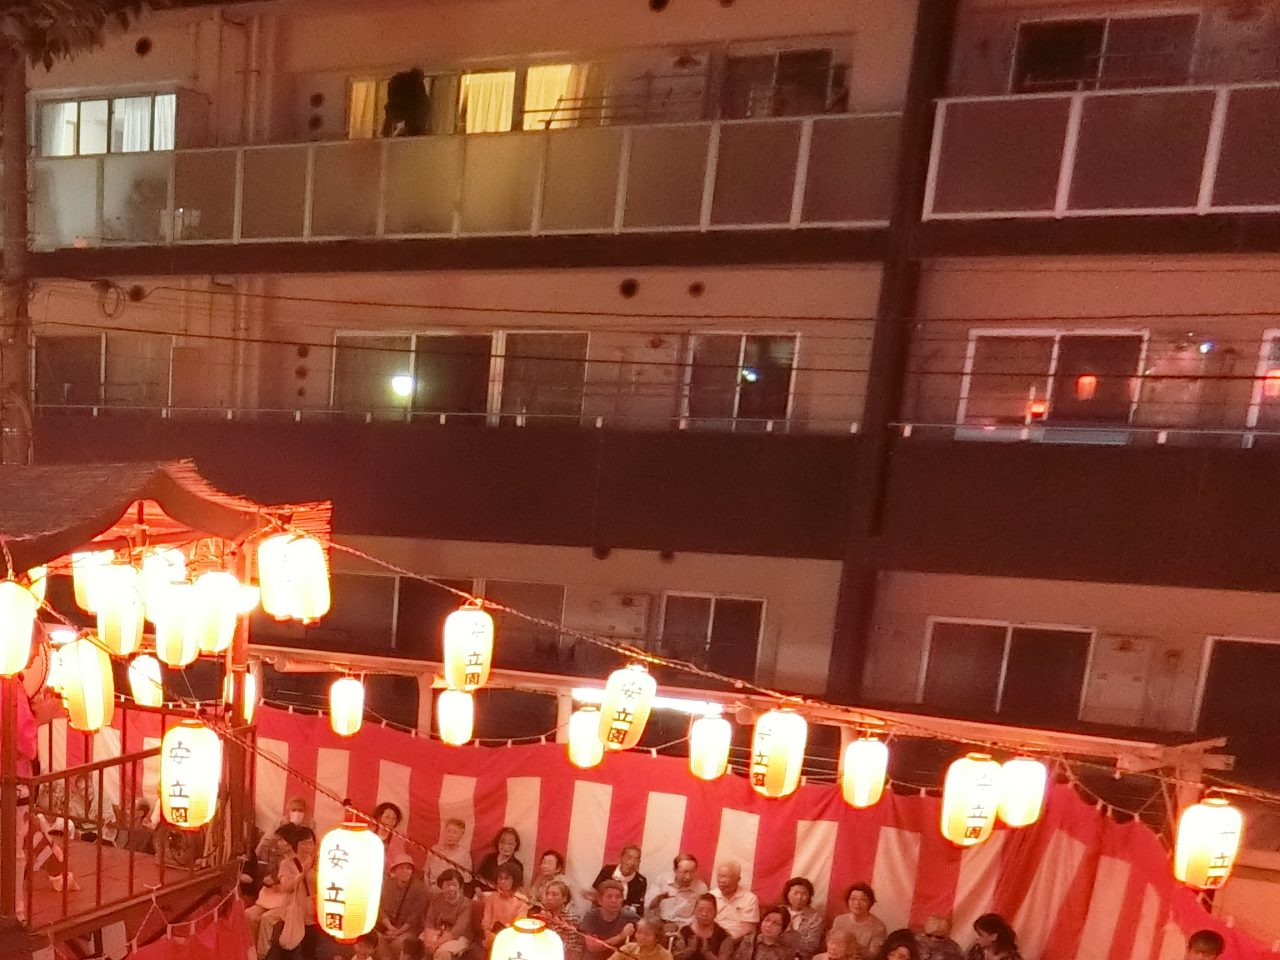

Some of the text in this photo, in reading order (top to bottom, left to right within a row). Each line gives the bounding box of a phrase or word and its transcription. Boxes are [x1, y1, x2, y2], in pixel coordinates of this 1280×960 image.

[169, 741, 191, 822] 安立園
[324, 844, 349, 930] 安立園
